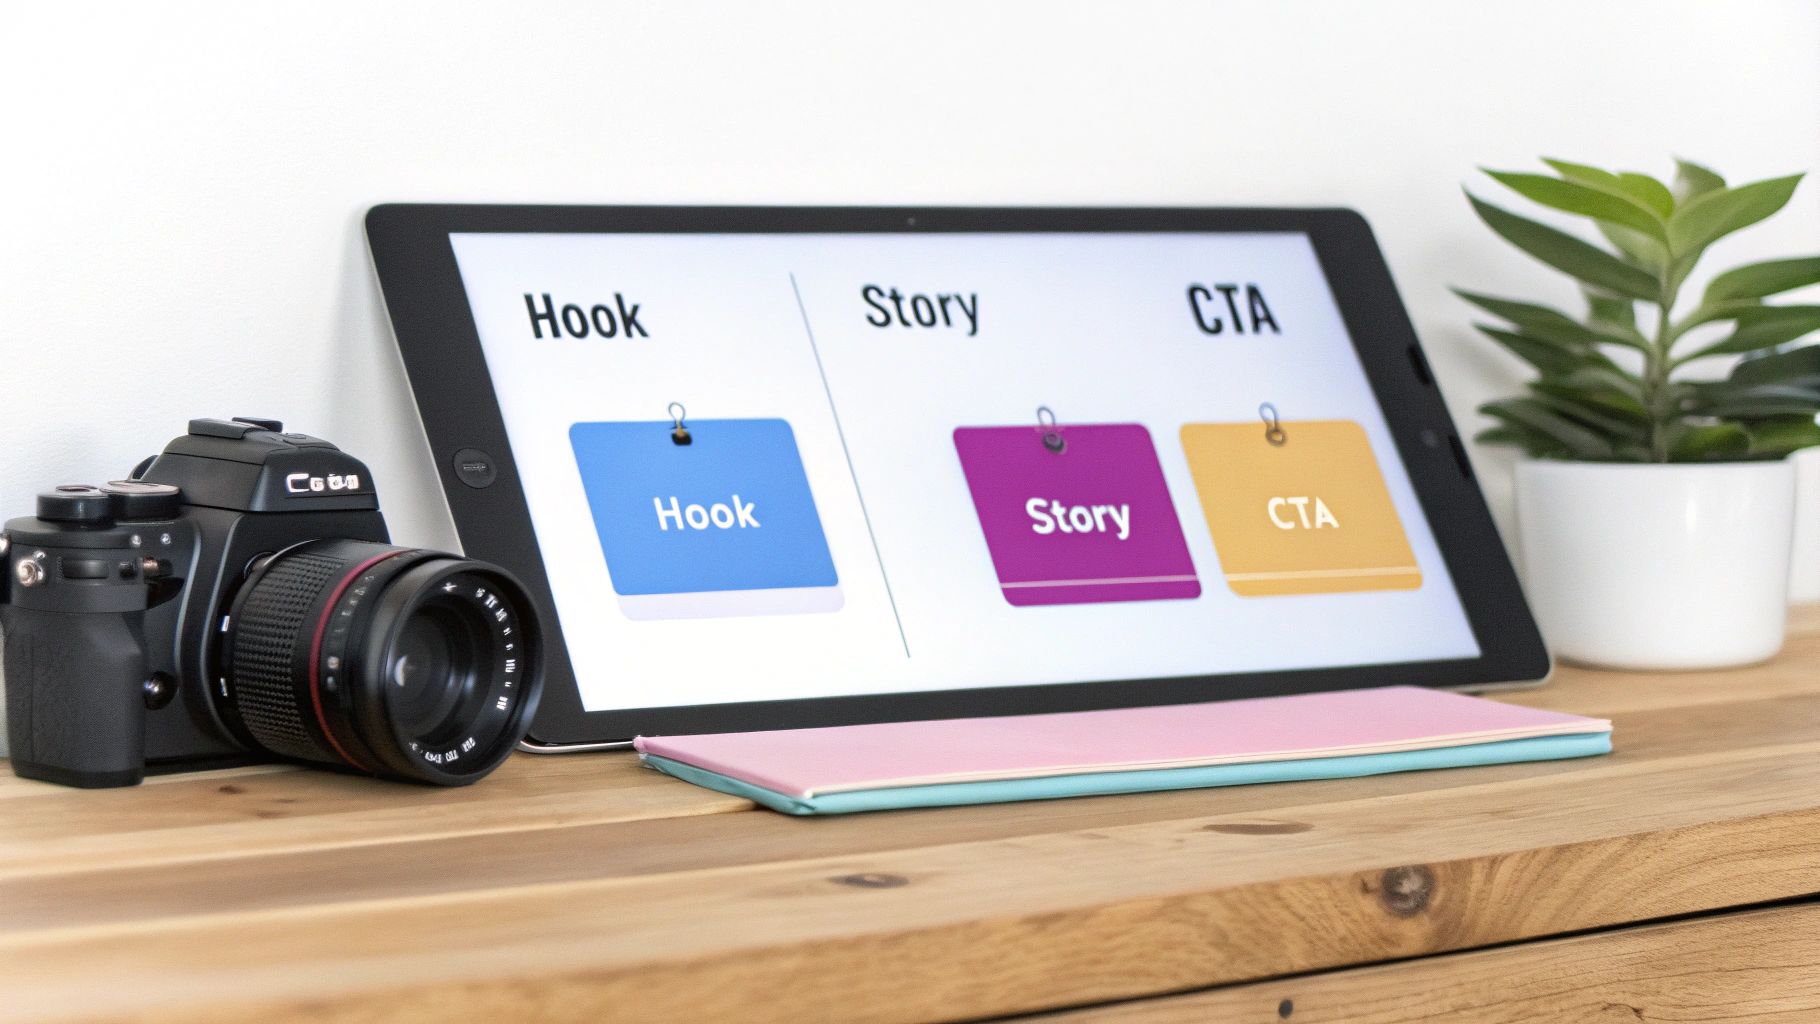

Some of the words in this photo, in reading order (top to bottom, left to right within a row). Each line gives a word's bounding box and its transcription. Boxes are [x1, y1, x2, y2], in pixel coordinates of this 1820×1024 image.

[524, 293, 649, 340] Hook
[862, 284, 980, 336] Story
[1187, 284, 1281, 336] CTA
[653, 494, 761, 532] Hook
[1025, 496, 1131, 541] Story
[1267, 496, 1339, 531] CTA
